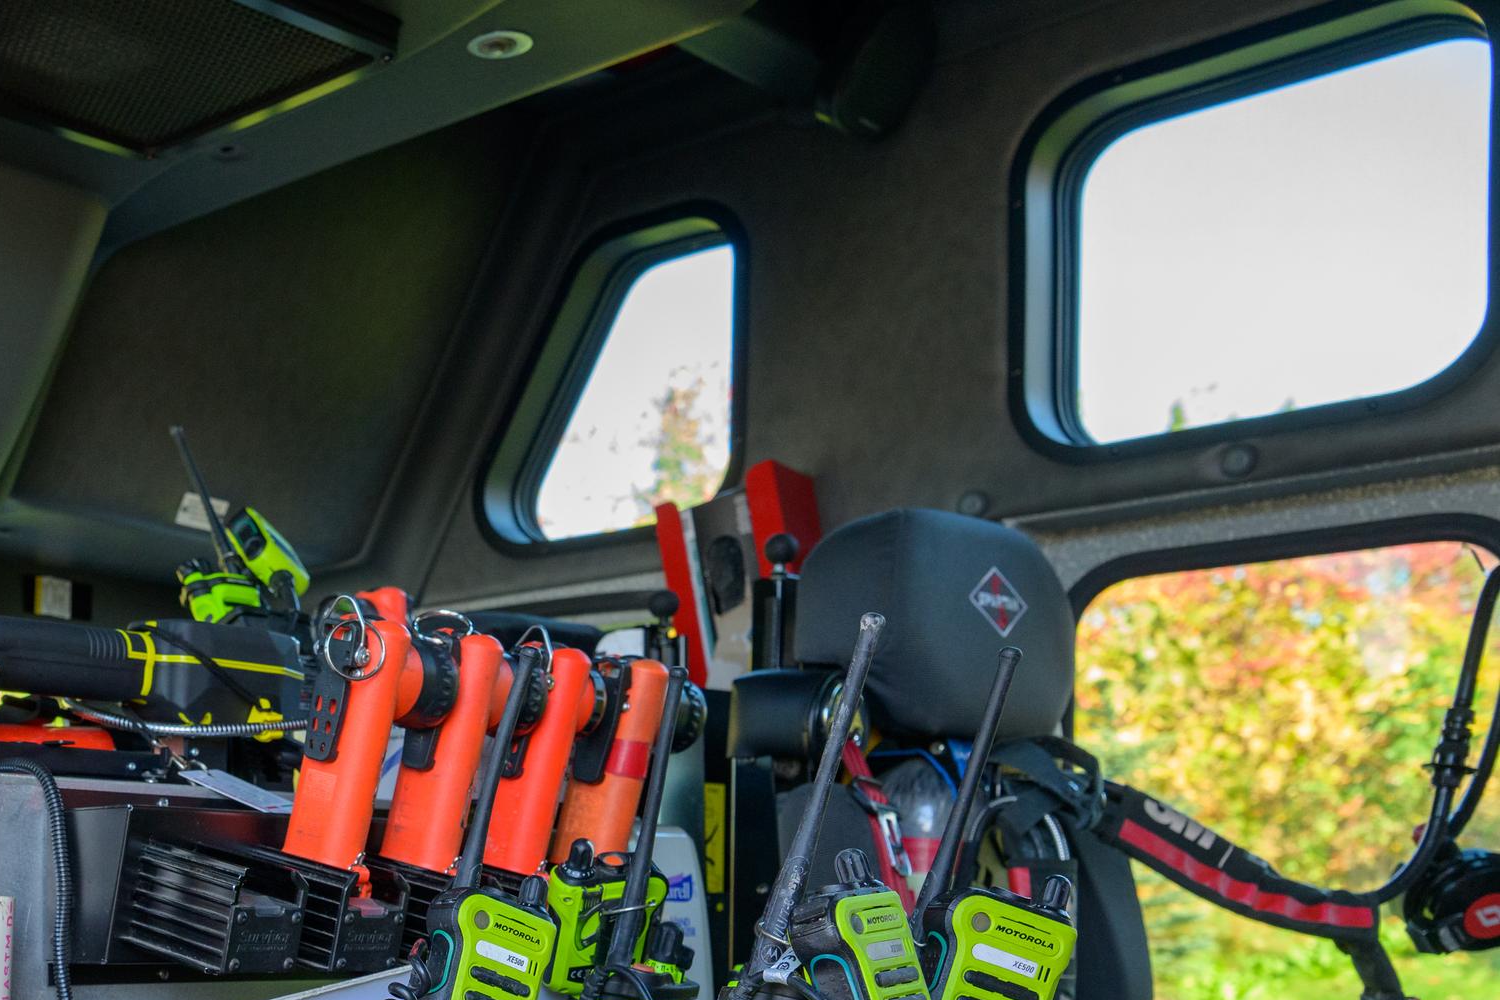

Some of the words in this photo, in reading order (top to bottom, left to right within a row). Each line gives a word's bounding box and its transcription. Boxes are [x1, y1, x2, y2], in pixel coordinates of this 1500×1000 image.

[493, 921, 541, 945] MOTOROLA
[995, 925, 1054, 950] MOTOROLA
[506, 954, 525, 967] XE500
[1012, 960, 1035, 974] XE500
